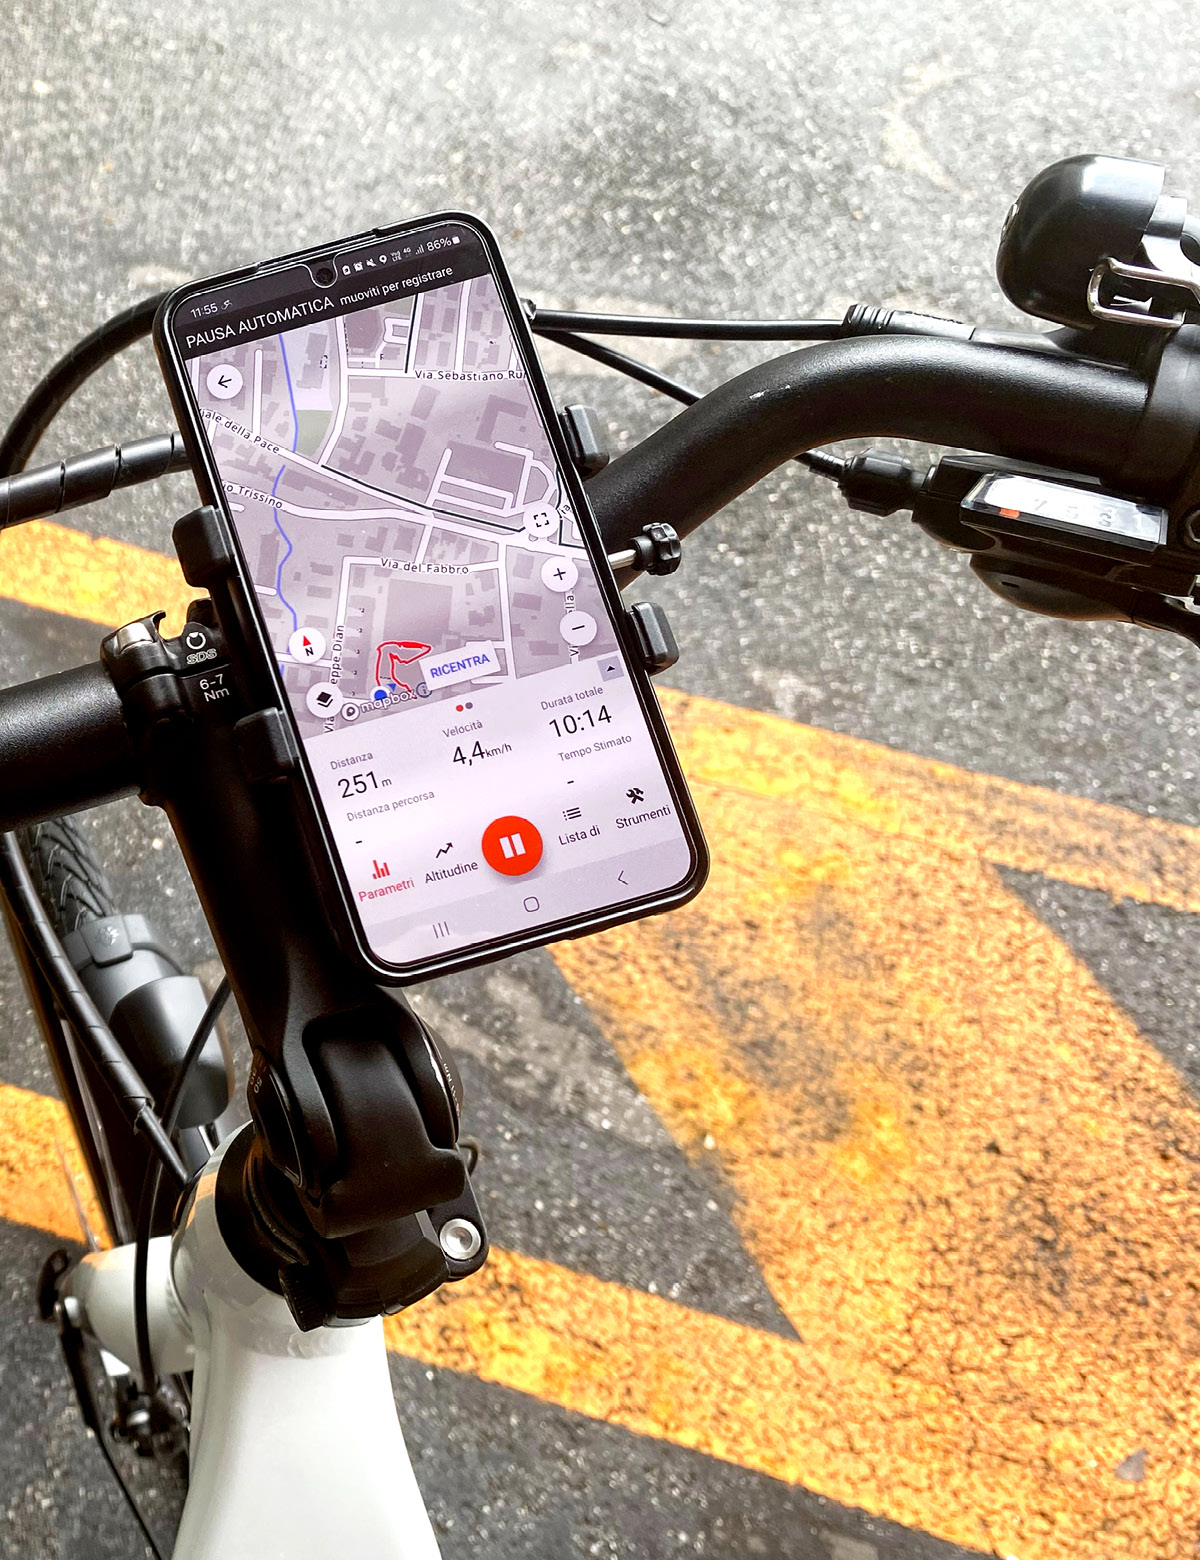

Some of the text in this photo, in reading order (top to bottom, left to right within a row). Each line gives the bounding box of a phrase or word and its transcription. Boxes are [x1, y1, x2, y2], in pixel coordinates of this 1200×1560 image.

[426, 237, 452, 252] 86%
[185, 266, 454, 349] PAUSA AUTOMATICA muoviti per registrare
[190, 302, 218, 319] 11:55
[414, 370, 433, 380] Via
[437, 370, 504, 381] Sebastiano
[224, 420, 251, 440] della
[253, 435, 280, 454] Pace
[239, 486, 283, 509] Trissino
[380, 557, 470, 575] Via del Fabbro
[186, 648, 218, 665] SDS
[305, 647, 314, 656] N
[429, 652, 491, 681] RICENTRA
[199, 673, 224, 690] 6-7
[203, 688, 230, 702] Nm
[361, 690, 417, 713] mapbox
[540, 685, 605, 712] Durata totale
[441, 718, 484, 739] Velocità
[548, 704, 613, 741] 10:14
[330, 750, 374, 770] Distanza
[557, 734, 633, 764] Tempo Stimato
[346, 790, 435, 822] Distanza percorsa
[615, 804, 672, 830] Strumenti
[559, 824, 601, 846] Lista di
[424, 859, 479, 884] Altitudine
[358, 876, 415, 903] Parametri
